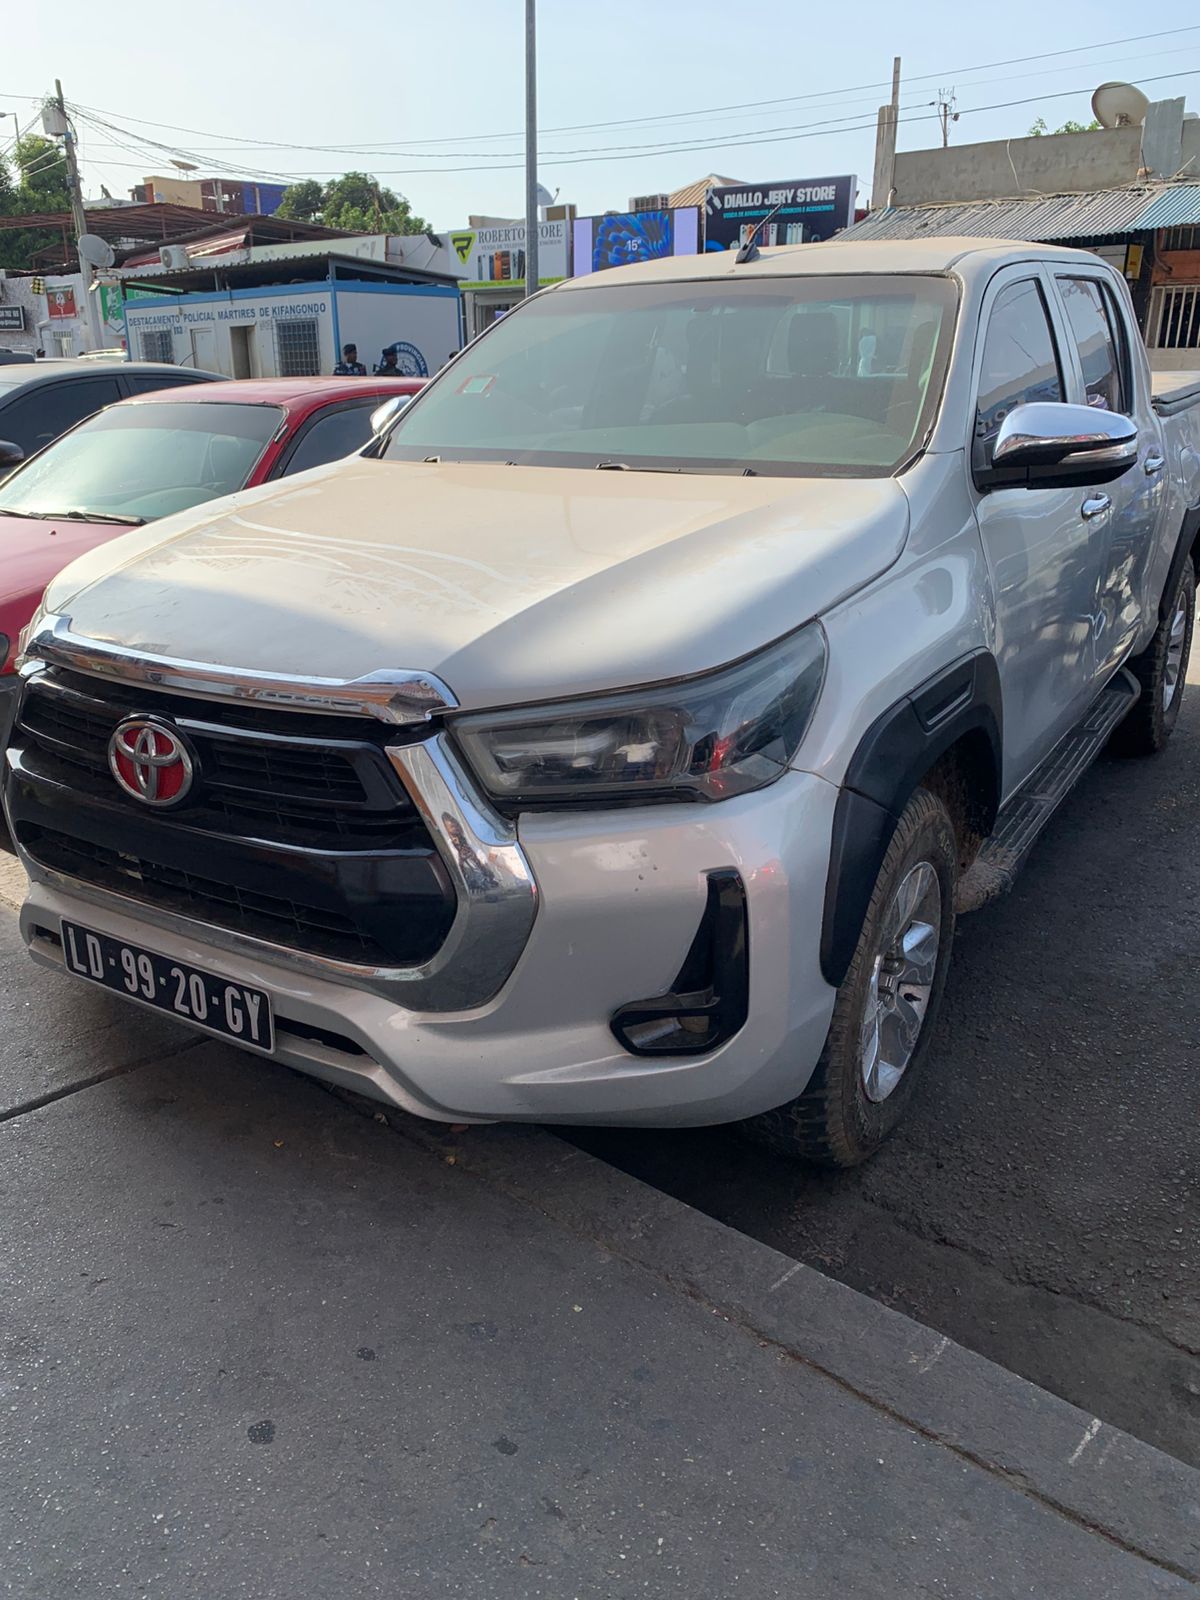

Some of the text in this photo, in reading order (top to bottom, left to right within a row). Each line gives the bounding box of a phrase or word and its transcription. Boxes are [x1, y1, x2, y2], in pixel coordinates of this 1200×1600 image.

[724, 185, 836, 209] DIALLO JERY STORE
[478, 227, 526, 243] ROBERTO
[128, 314, 180, 327] DESTACAMENTO
[218, 307, 256, 320] MÁRTIRES
[259, 306, 270, 317] DE
[271, 302, 326, 316] KIFANGONDO
[396, 343, 427, 371] PROVINCIAL
